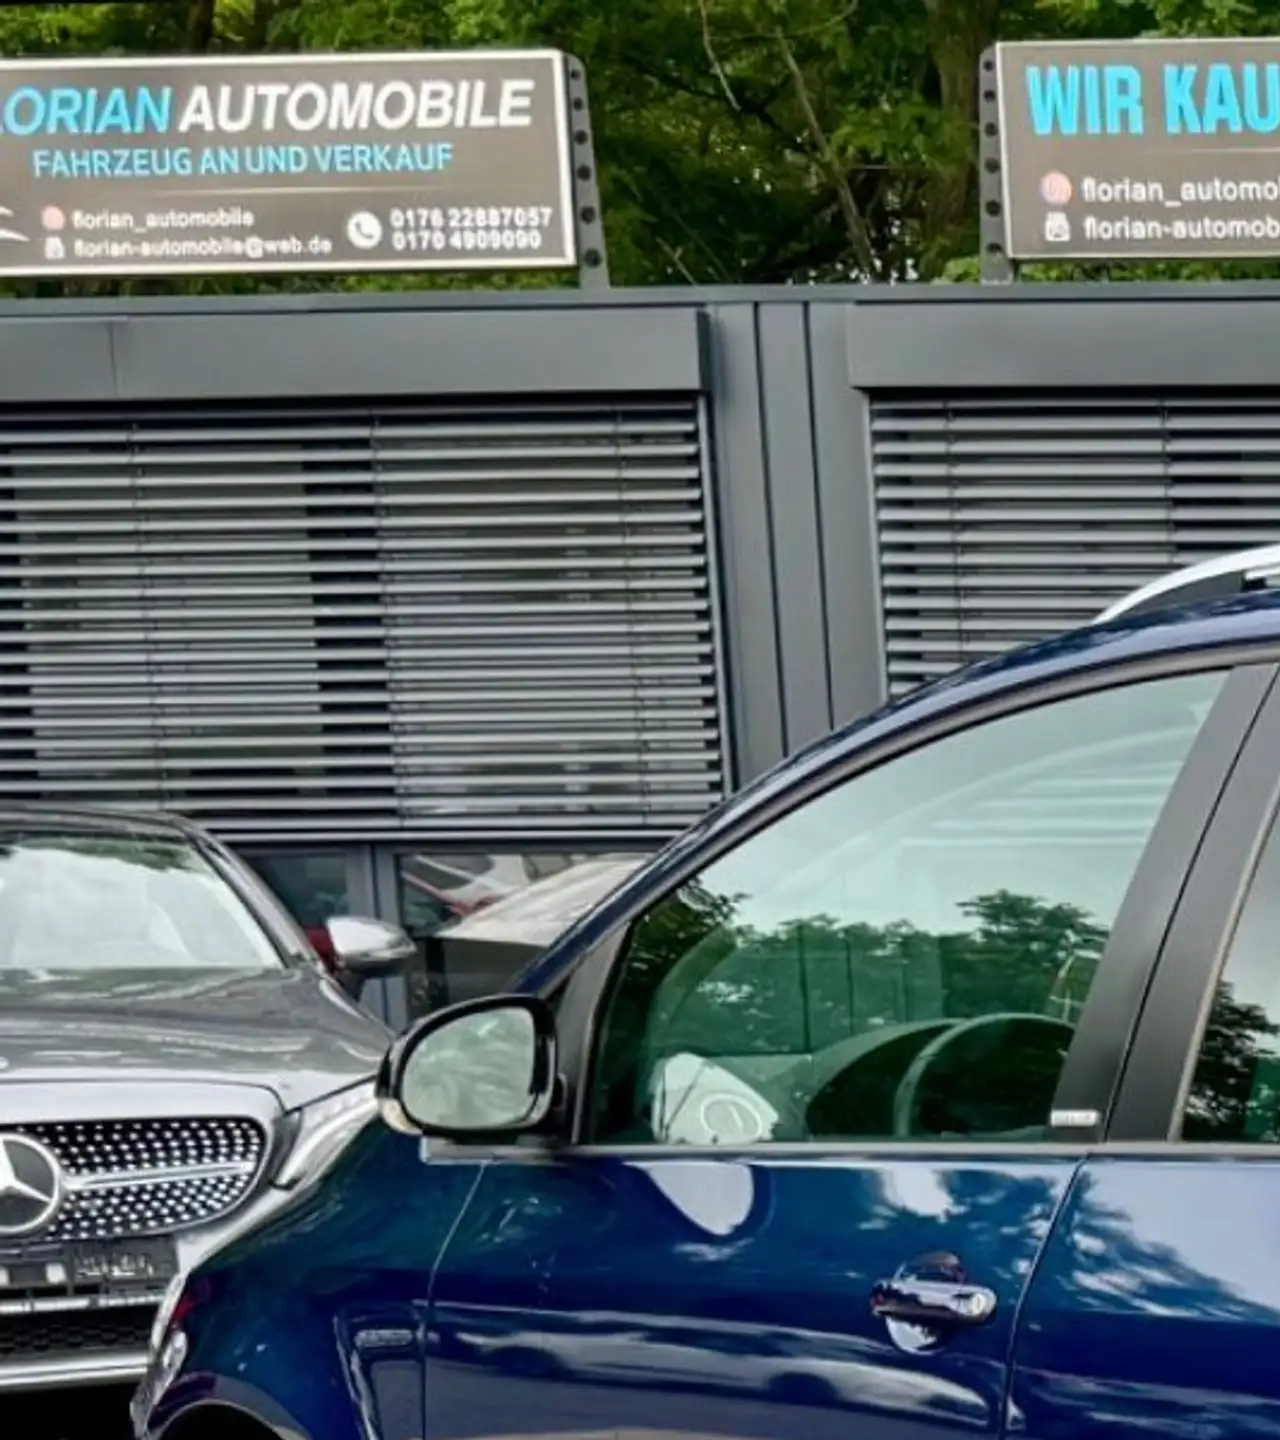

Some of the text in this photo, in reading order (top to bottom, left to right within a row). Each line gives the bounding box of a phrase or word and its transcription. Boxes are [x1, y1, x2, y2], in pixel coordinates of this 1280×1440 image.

[0, 79, 535, 135] ORIAN AUTOMOBILE
[1026, 65, 1144, 134] WIR
[33, 143, 453, 177] FAHRZEUG AN UND VERKAUF
